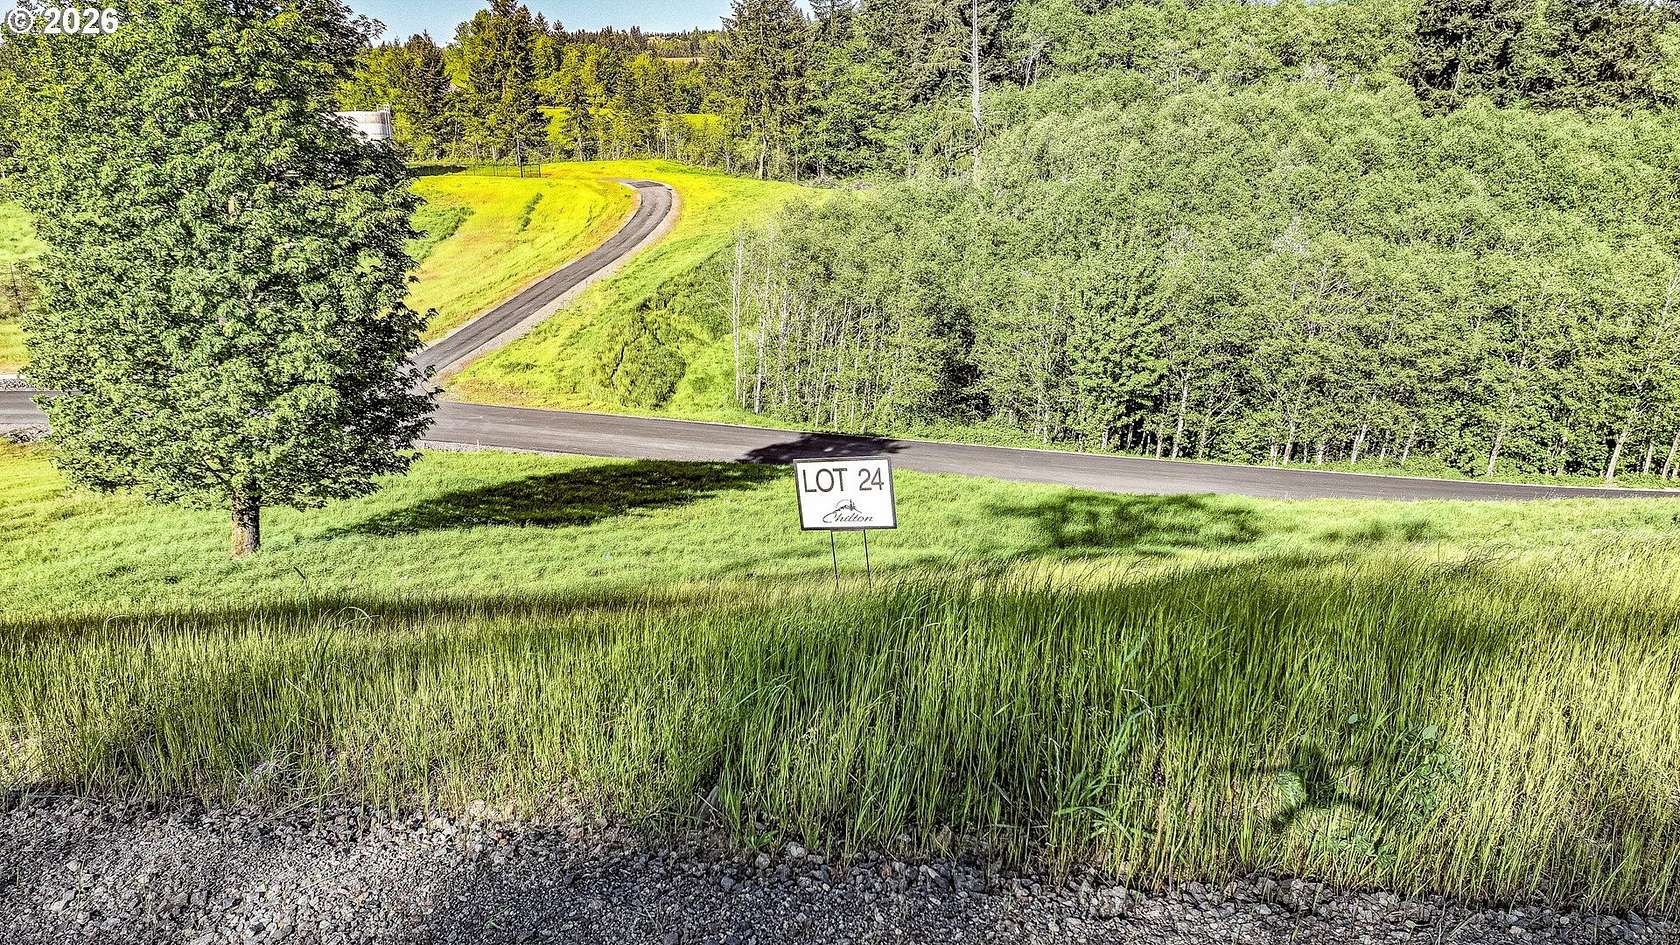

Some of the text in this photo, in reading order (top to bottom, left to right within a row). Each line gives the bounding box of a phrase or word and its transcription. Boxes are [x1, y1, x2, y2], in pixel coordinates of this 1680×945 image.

[802, 467, 885, 493] LOT 24
[822, 511, 874, 523] Chilton
